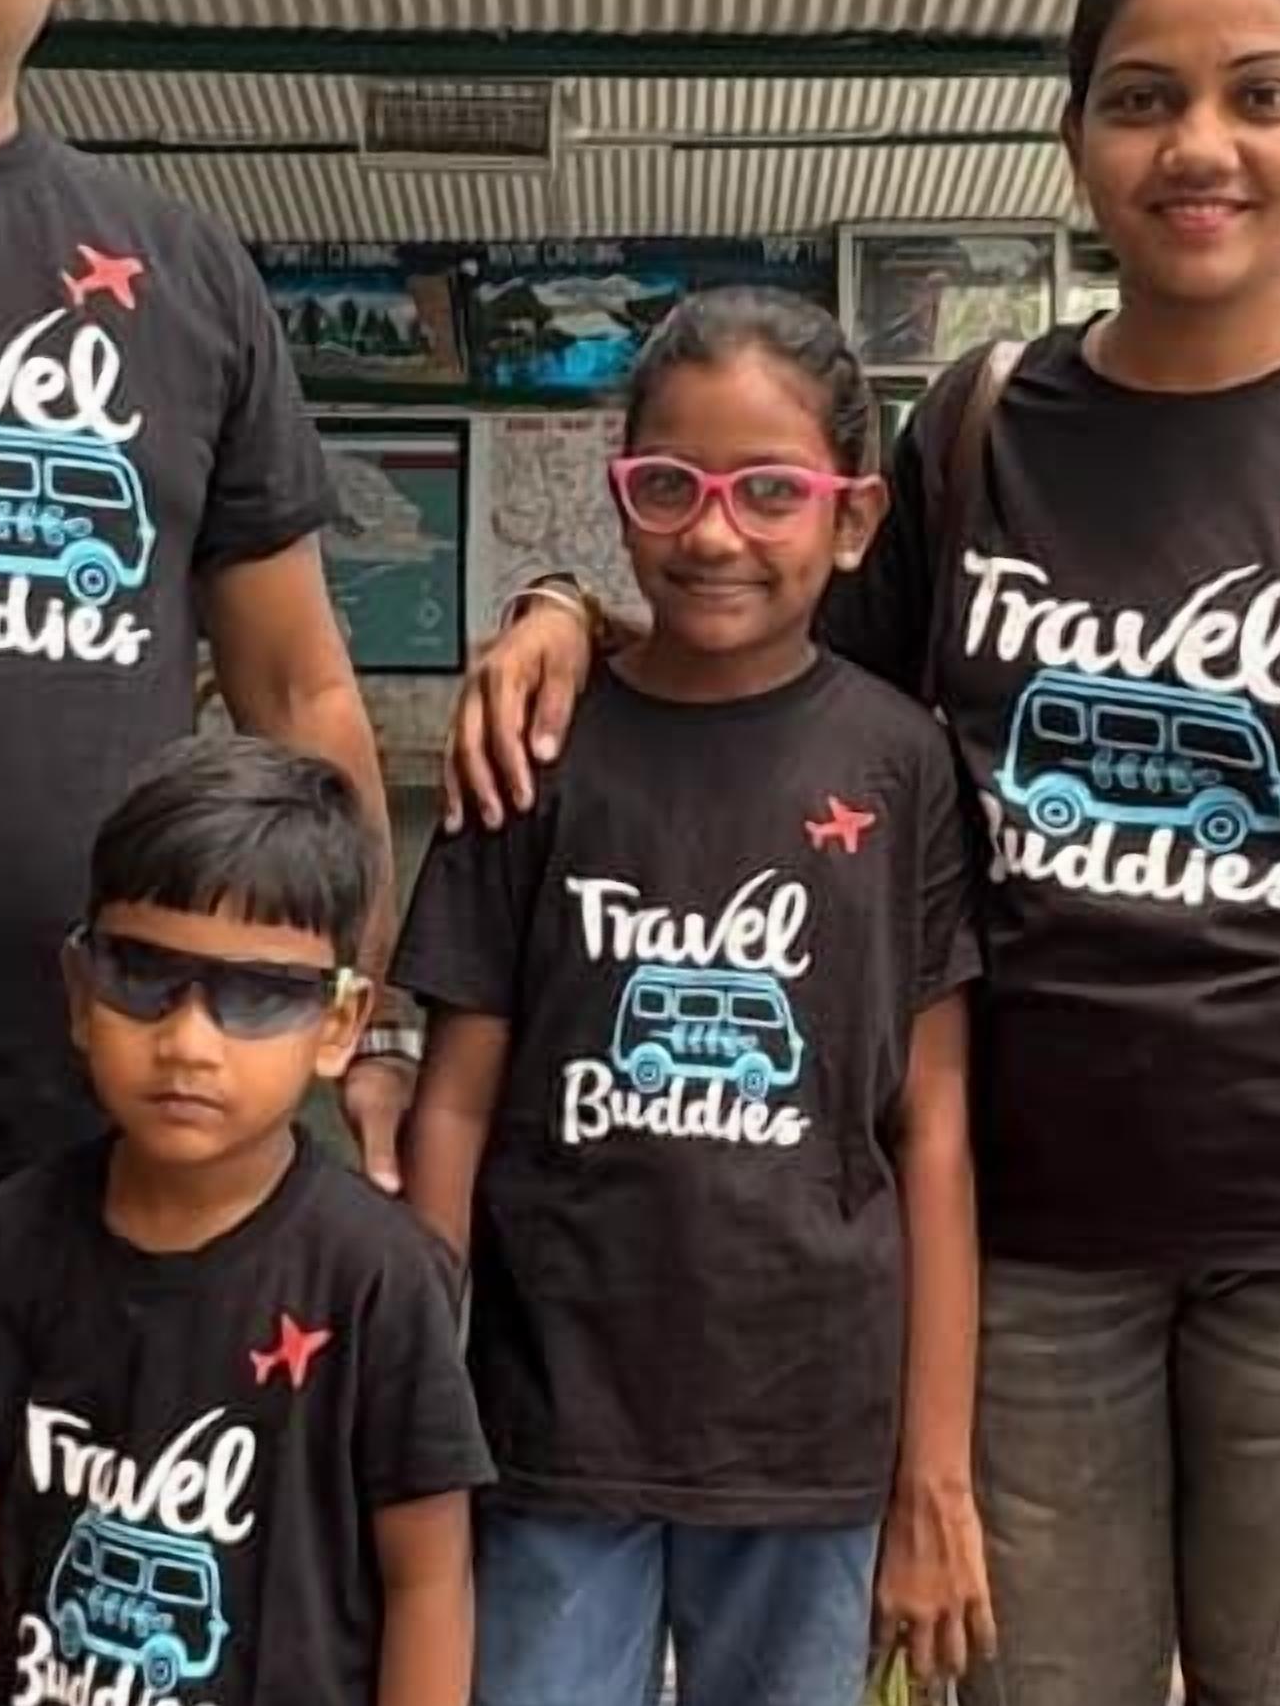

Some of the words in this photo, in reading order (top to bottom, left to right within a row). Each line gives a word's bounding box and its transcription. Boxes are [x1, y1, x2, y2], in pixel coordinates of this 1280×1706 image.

[565, 868, 812, 977] Travel
[562, 1058, 811, 1144] Buddies
[26, 1399, 257, 1544] Travel
